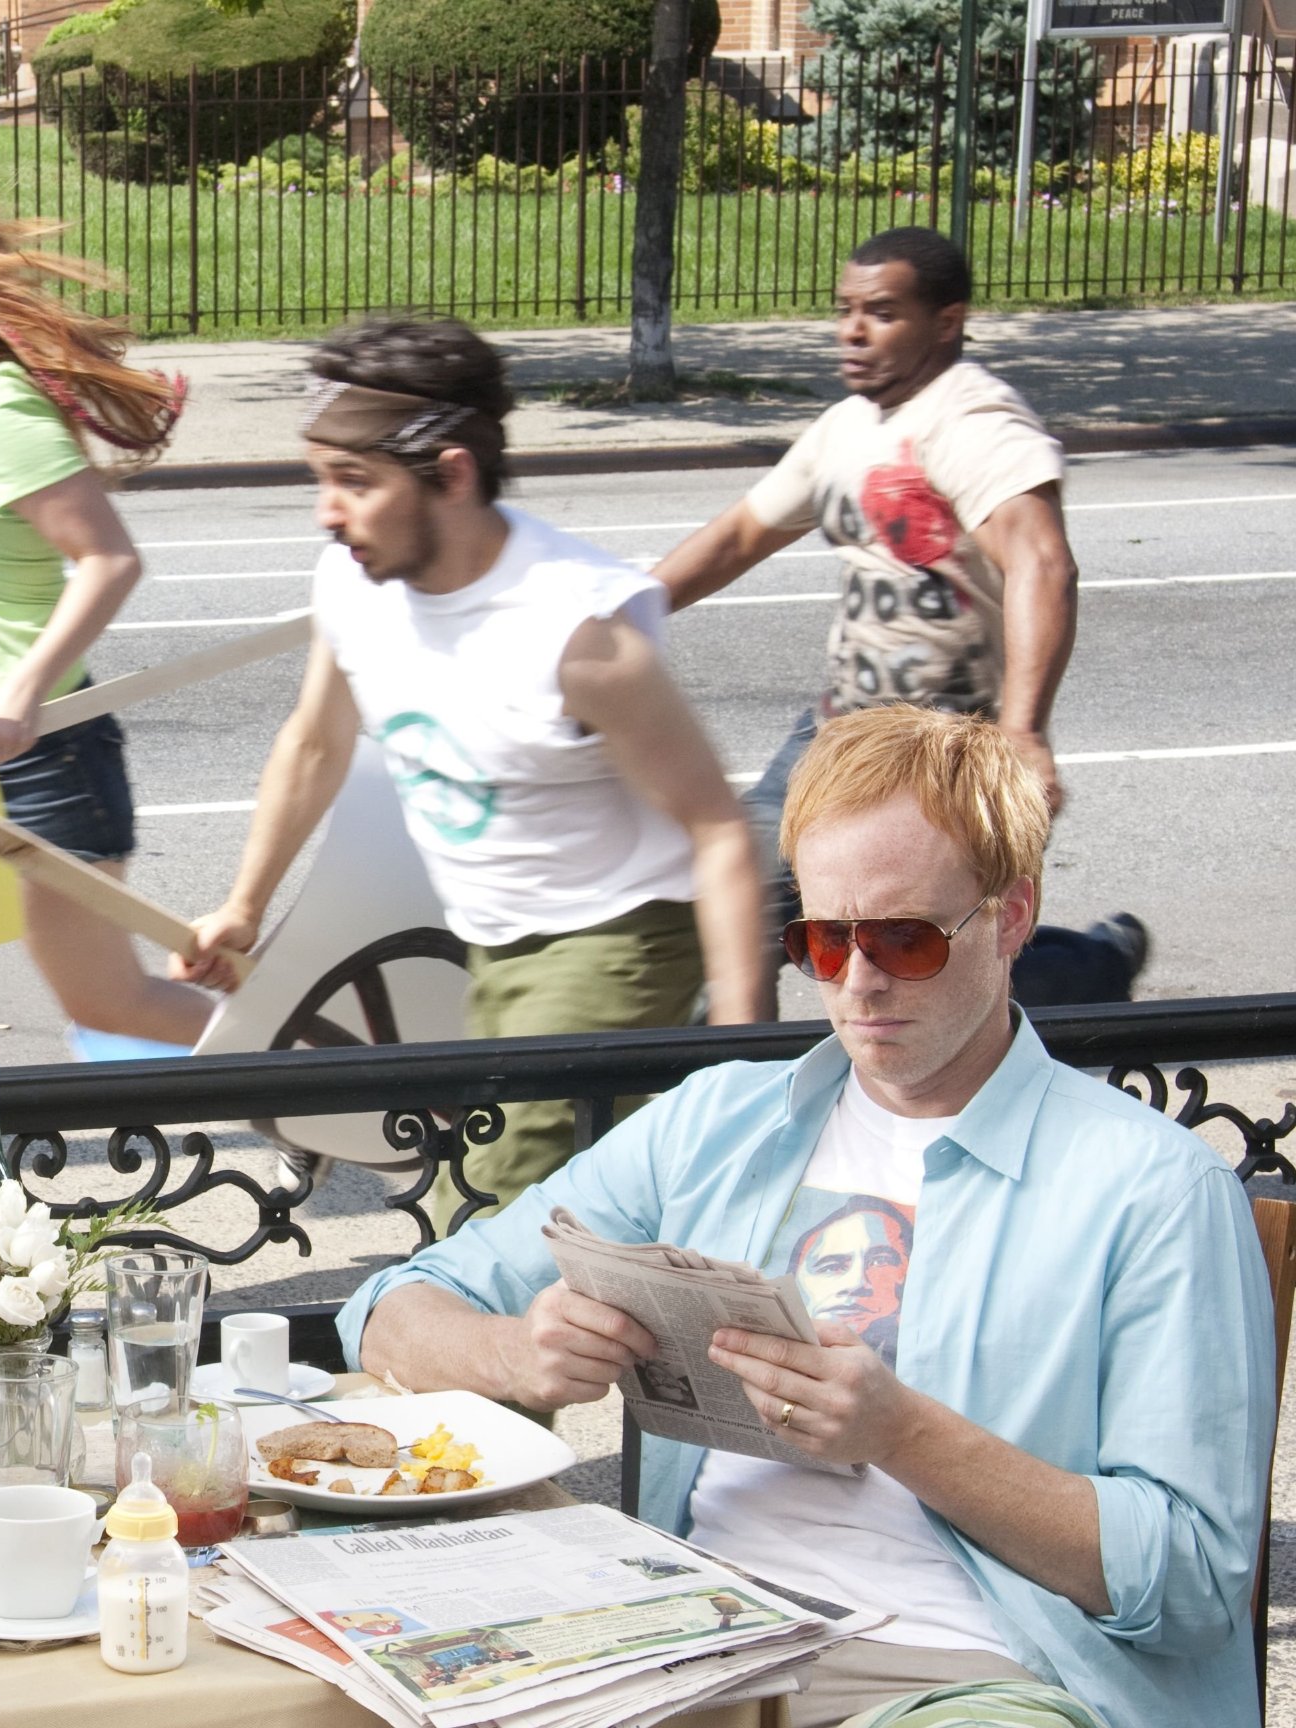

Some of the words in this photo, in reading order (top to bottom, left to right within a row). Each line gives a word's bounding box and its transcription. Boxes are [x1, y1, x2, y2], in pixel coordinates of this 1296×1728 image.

[1111, 8, 1145, 19] PEACE
[332, 1535, 405, 1555] Called
[398, 1526, 515, 1551] Manhattan
